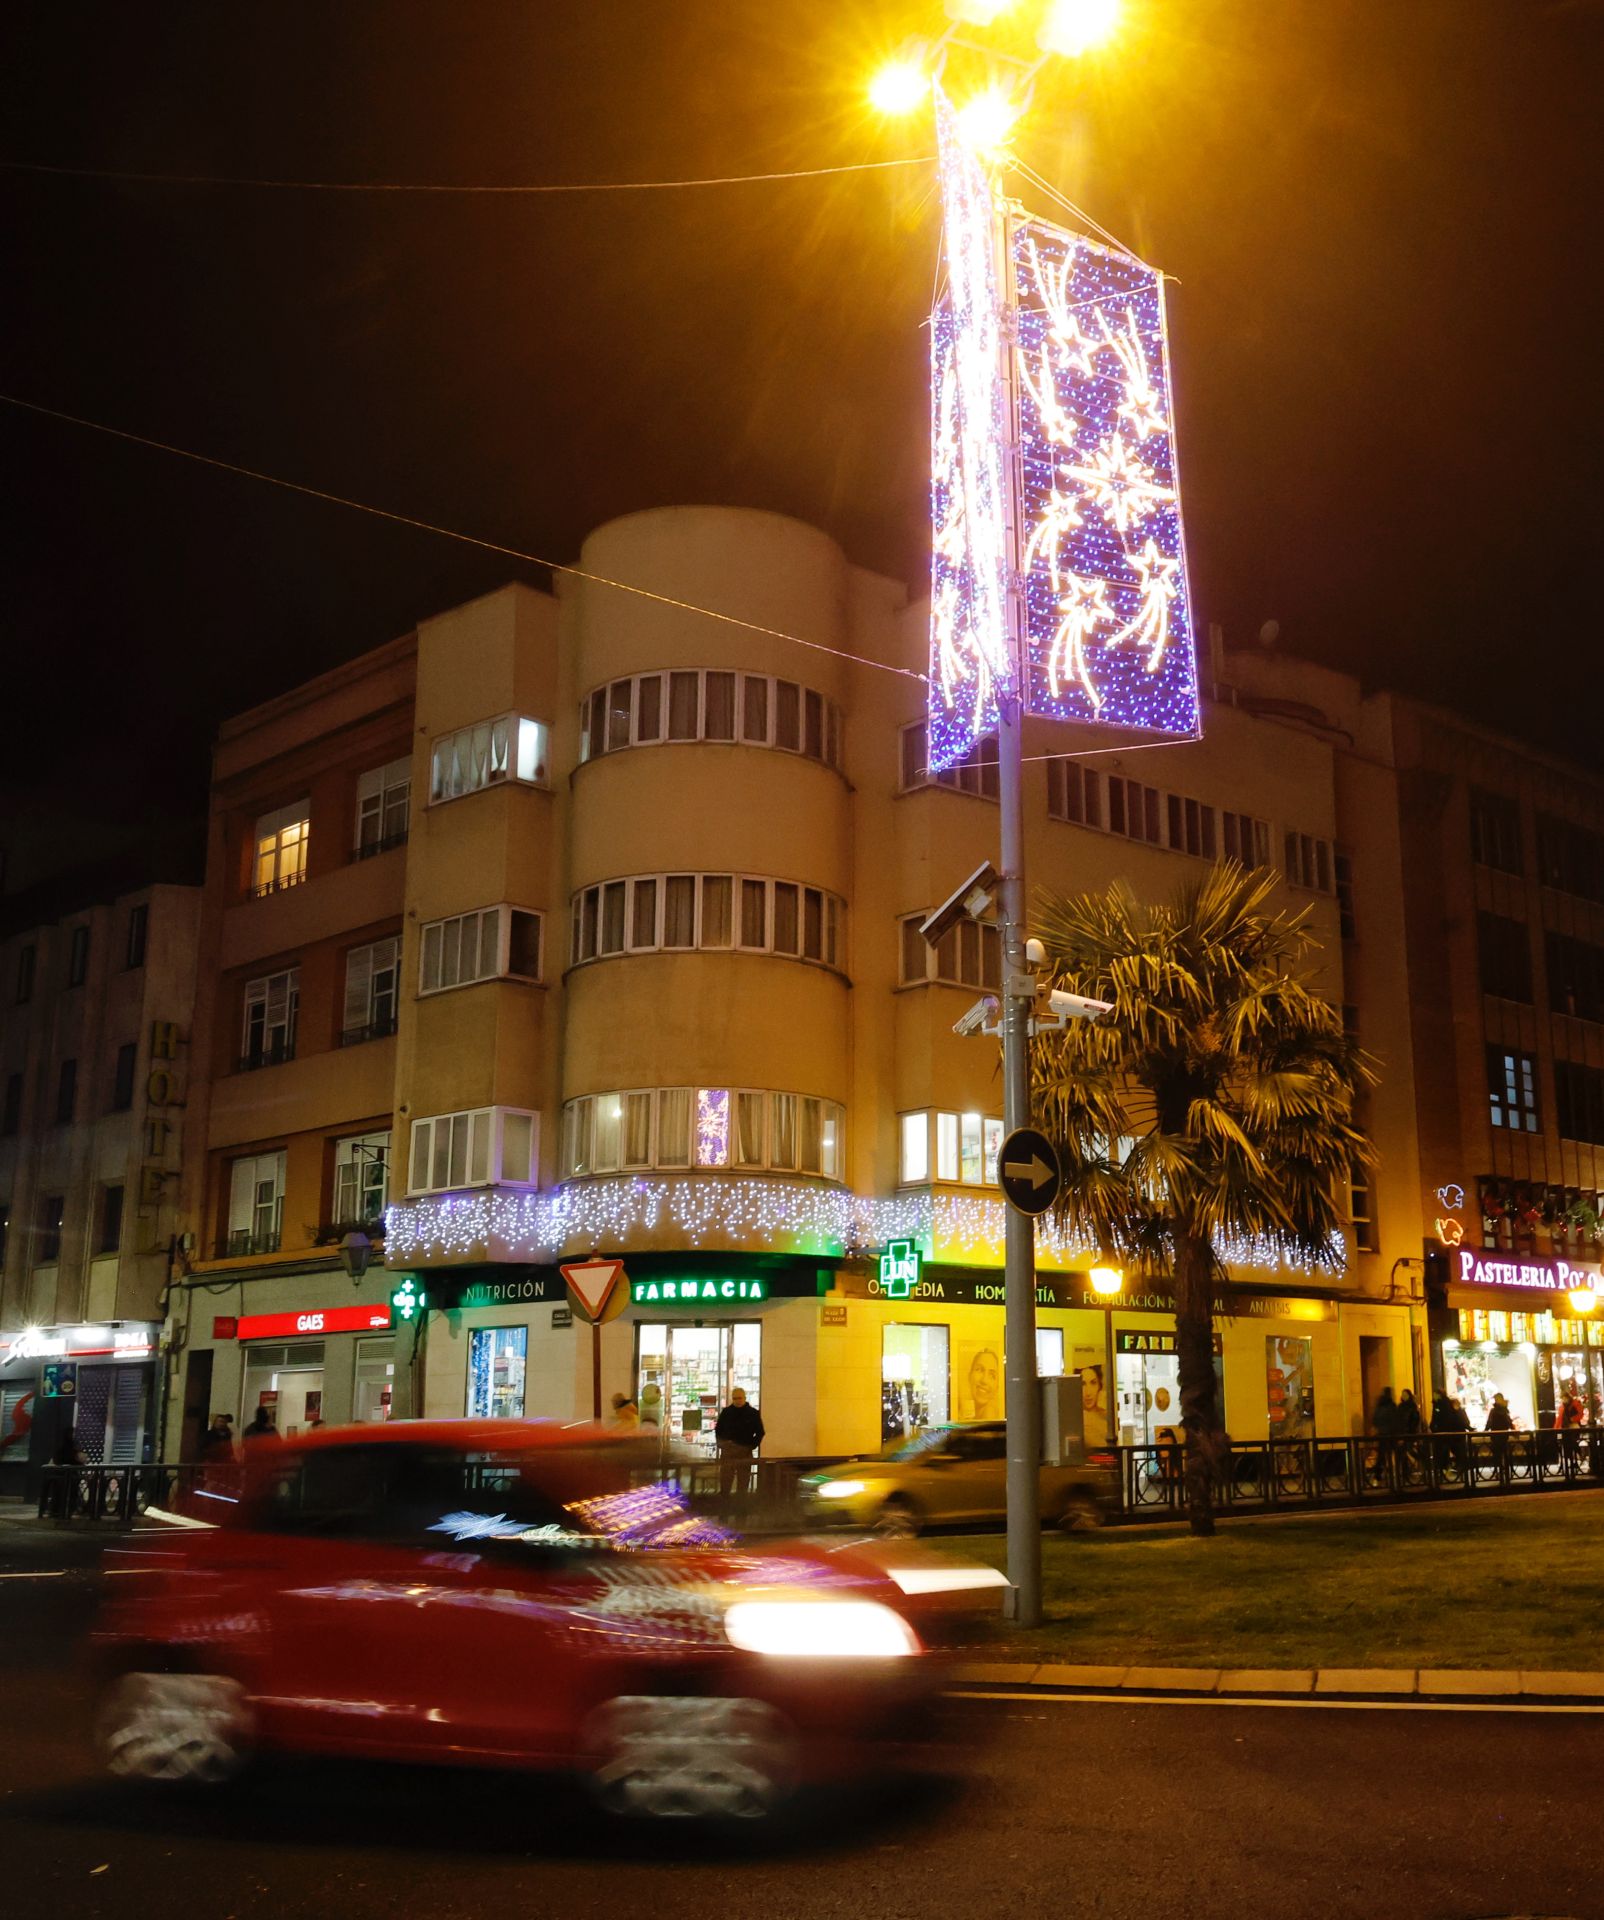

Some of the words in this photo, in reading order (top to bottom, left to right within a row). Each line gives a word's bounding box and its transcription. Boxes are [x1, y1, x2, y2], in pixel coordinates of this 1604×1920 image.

[136, 1020, 178, 1255] HOTEL
[466, 1280, 545, 1300] NUTRICIÓN
[635, 1281, 762, 1301] FARMACIA
[296, 1313, 325, 1331] GAES
